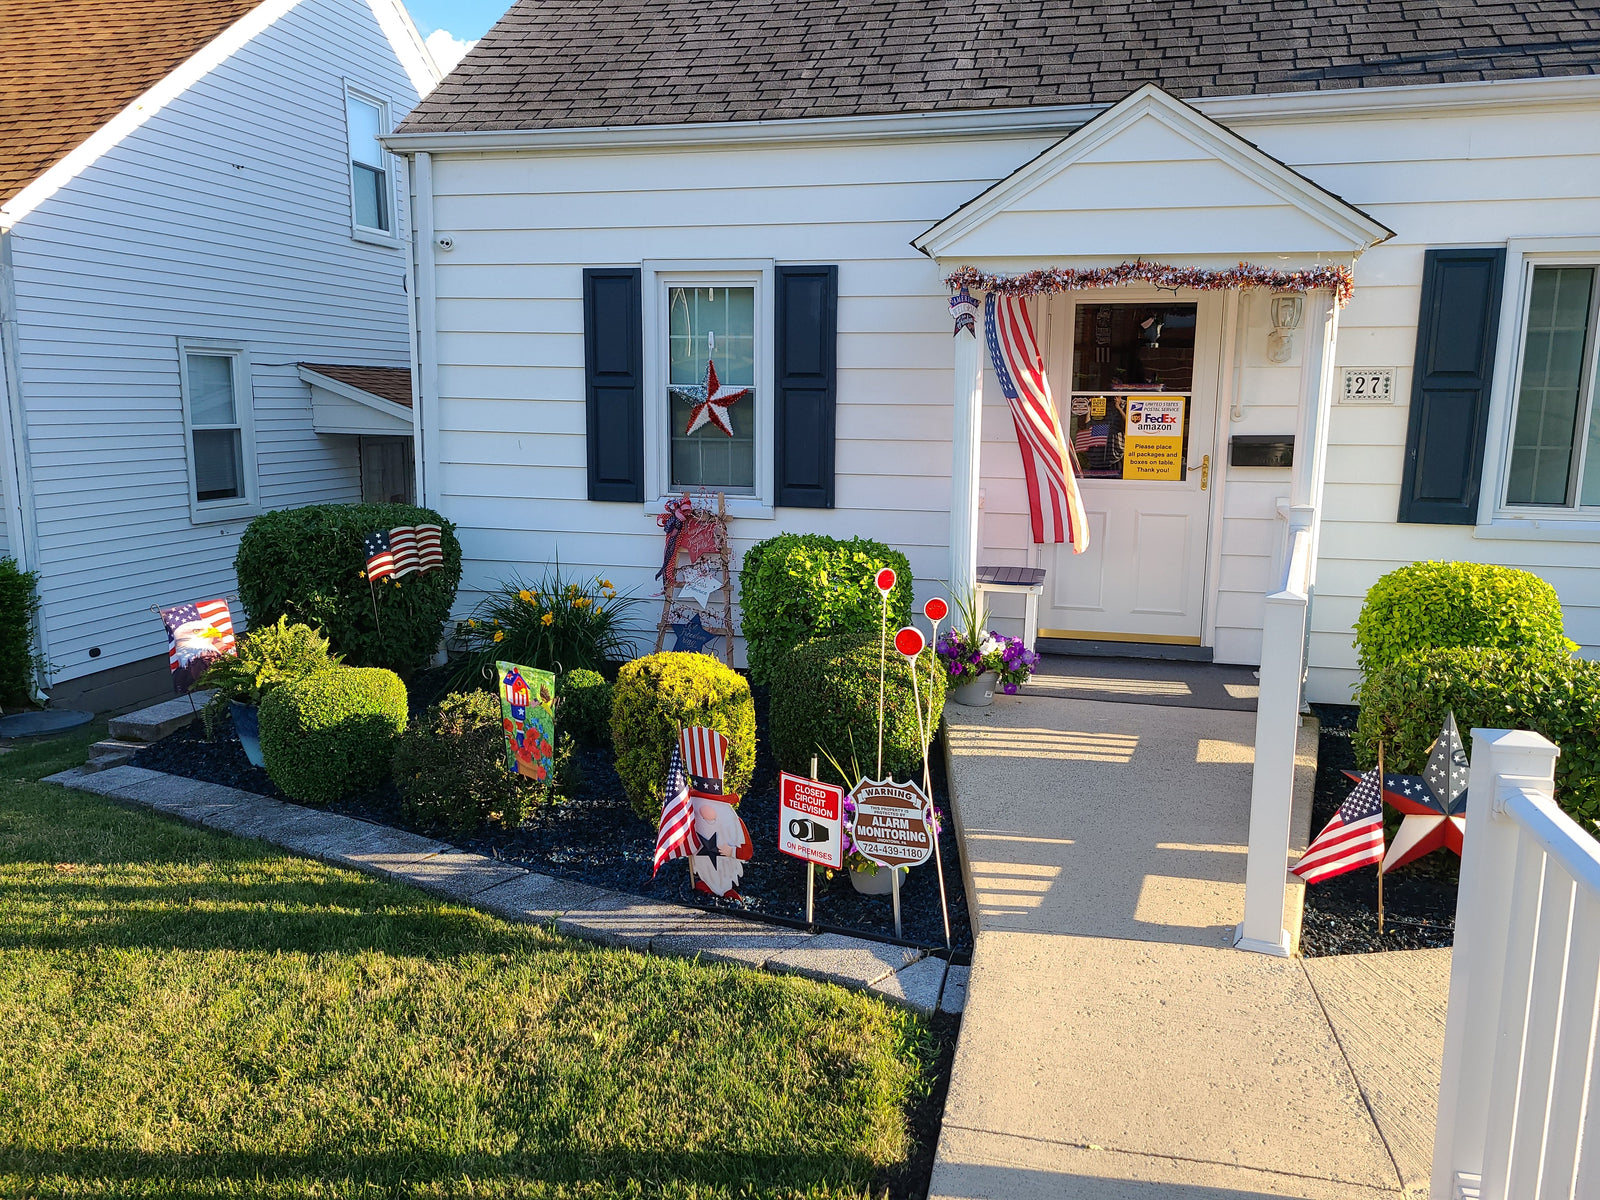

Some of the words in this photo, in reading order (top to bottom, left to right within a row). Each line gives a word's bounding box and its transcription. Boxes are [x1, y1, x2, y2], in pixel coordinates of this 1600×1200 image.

[1355, 376, 1380, 394] 27
[1145, 413, 1176, 423] FedEx
[794, 784, 827, 799] CLOSED
[865, 788, 913, 800] WARNING
[794, 792, 827, 807] CIRCUIT
[789, 799, 833, 818] TELEVISION
[872, 816, 910, 829] ALARM
[857, 825, 927, 843] MONITORING
[786, 841, 797, 850] ON
[797, 845, 833, 861] PREMISES
[863, 843, 923, 858] 724-439-1180
